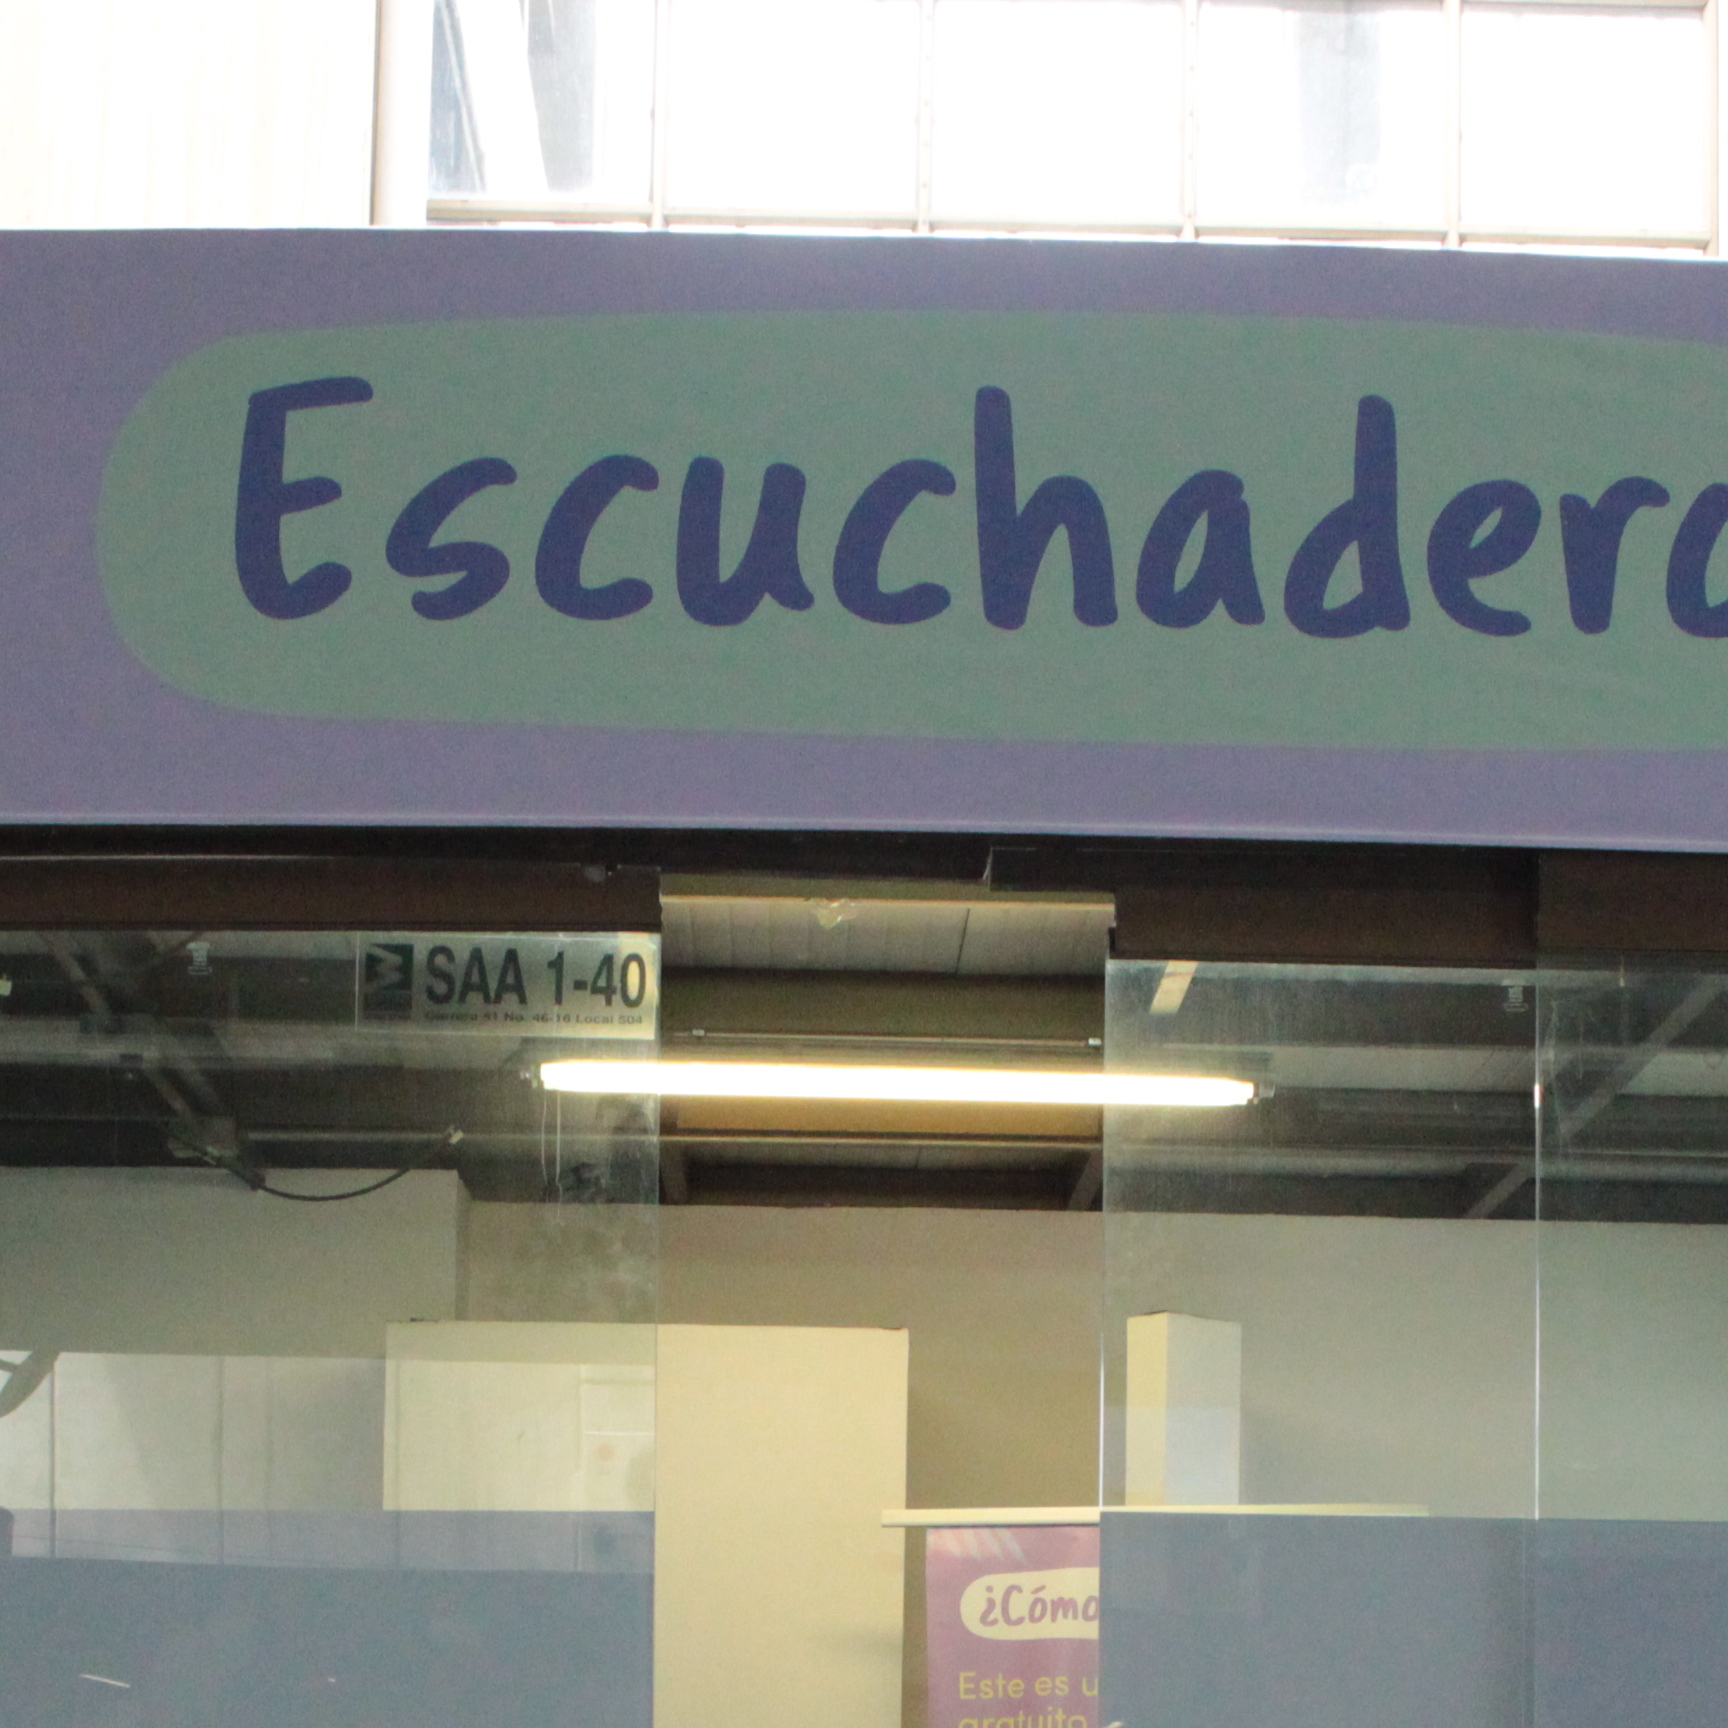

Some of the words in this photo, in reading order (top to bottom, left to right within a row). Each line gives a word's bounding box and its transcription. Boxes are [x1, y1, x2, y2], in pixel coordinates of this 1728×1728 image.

[425, 945, 527, 1005] SAA
[547, 950, 647, 1009] 1-40
[575, 1014, 614, 1025] Local
[618, 1014, 643, 1025] 504
[979, 1584, 1099, 1627] ¿Cómo
[959, 1672, 1025, 1700] Este
[1034, 1676, 1070, 1696] es
